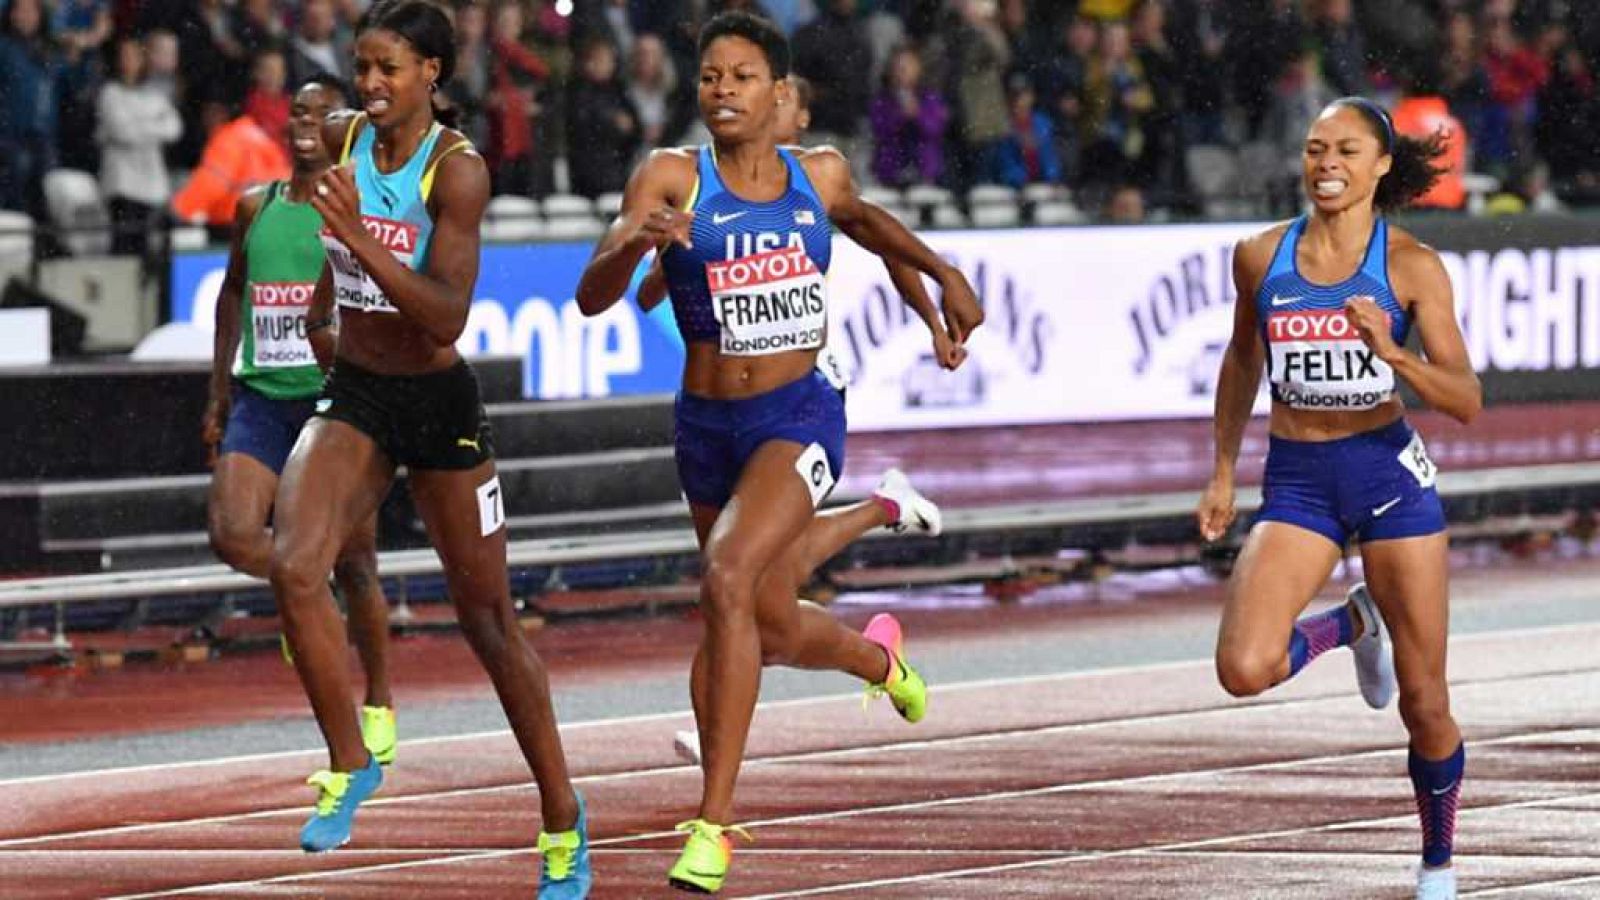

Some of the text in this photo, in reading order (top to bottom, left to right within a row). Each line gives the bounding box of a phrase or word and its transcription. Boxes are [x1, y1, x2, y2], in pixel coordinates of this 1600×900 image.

[719, 283, 824, 329] FRANCIS
[724, 328, 822, 351] LONDON 20
[1271, 314, 1360, 337] TOYO
[1284, 349, 1378, 382] FELIX
[486, 486, 499, 524] 7
